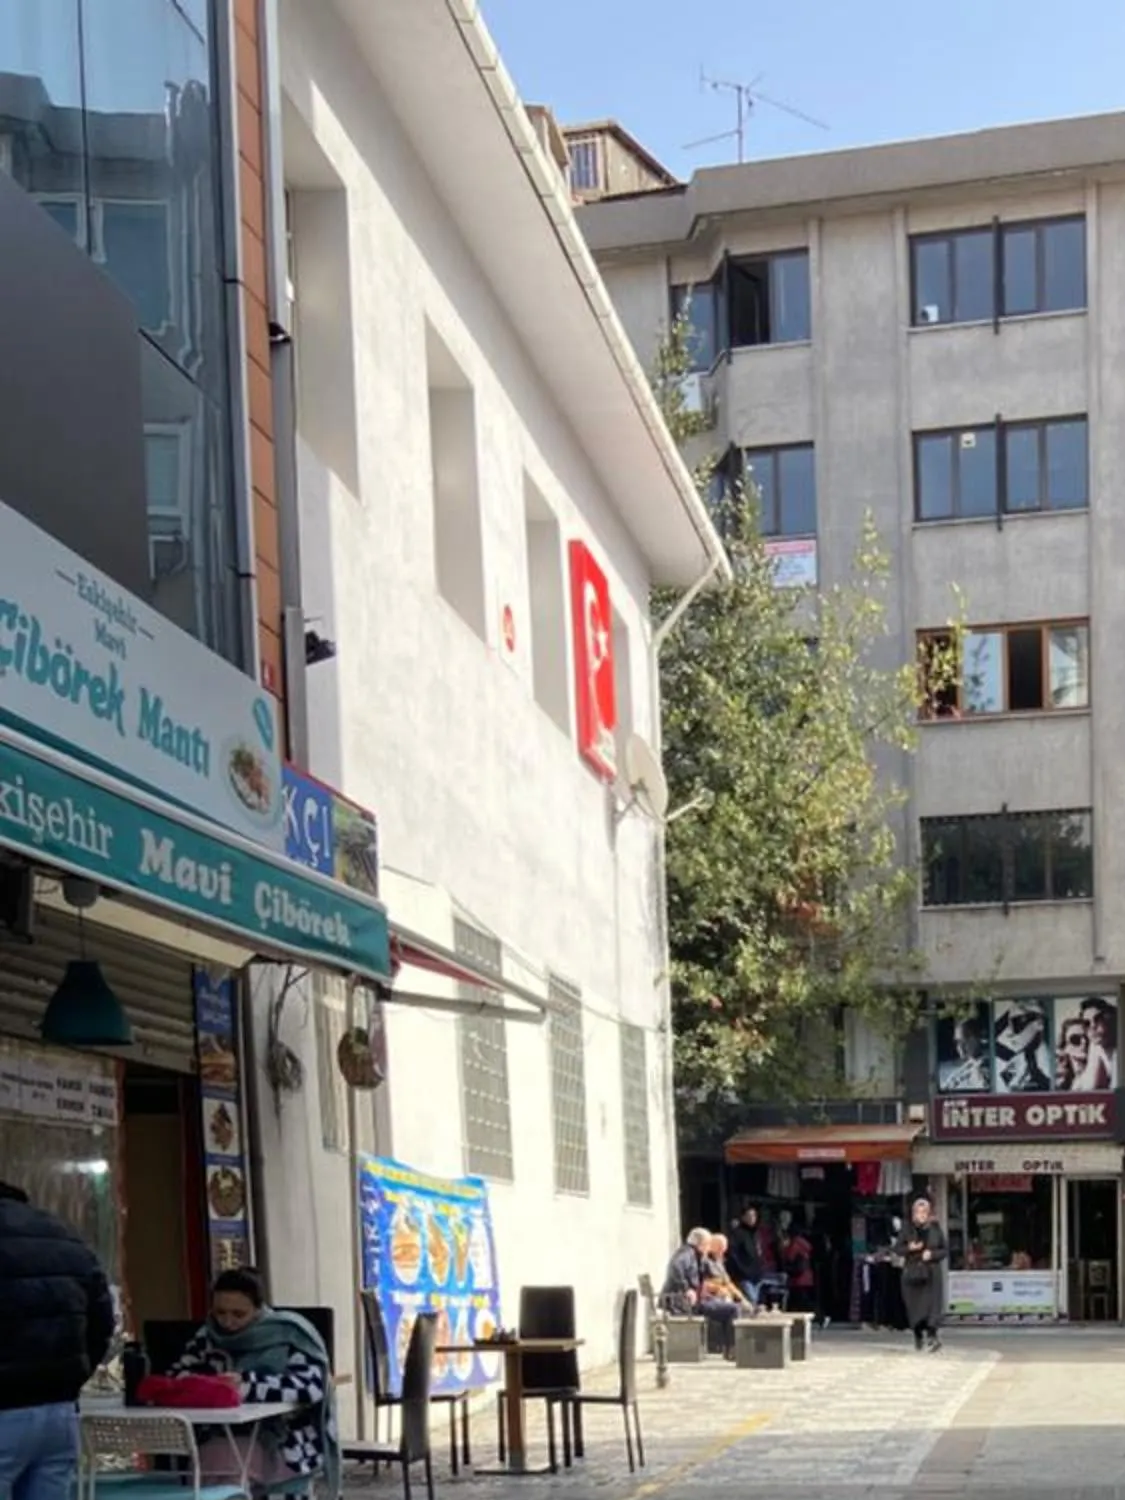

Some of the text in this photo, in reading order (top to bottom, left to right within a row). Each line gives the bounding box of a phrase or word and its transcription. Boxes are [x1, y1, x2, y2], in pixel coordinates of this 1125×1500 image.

[138, 687, 210, 778] Mantı
[139, 827, 233, 905] Mavi
[254, 880, 350, 948] Çibörek
